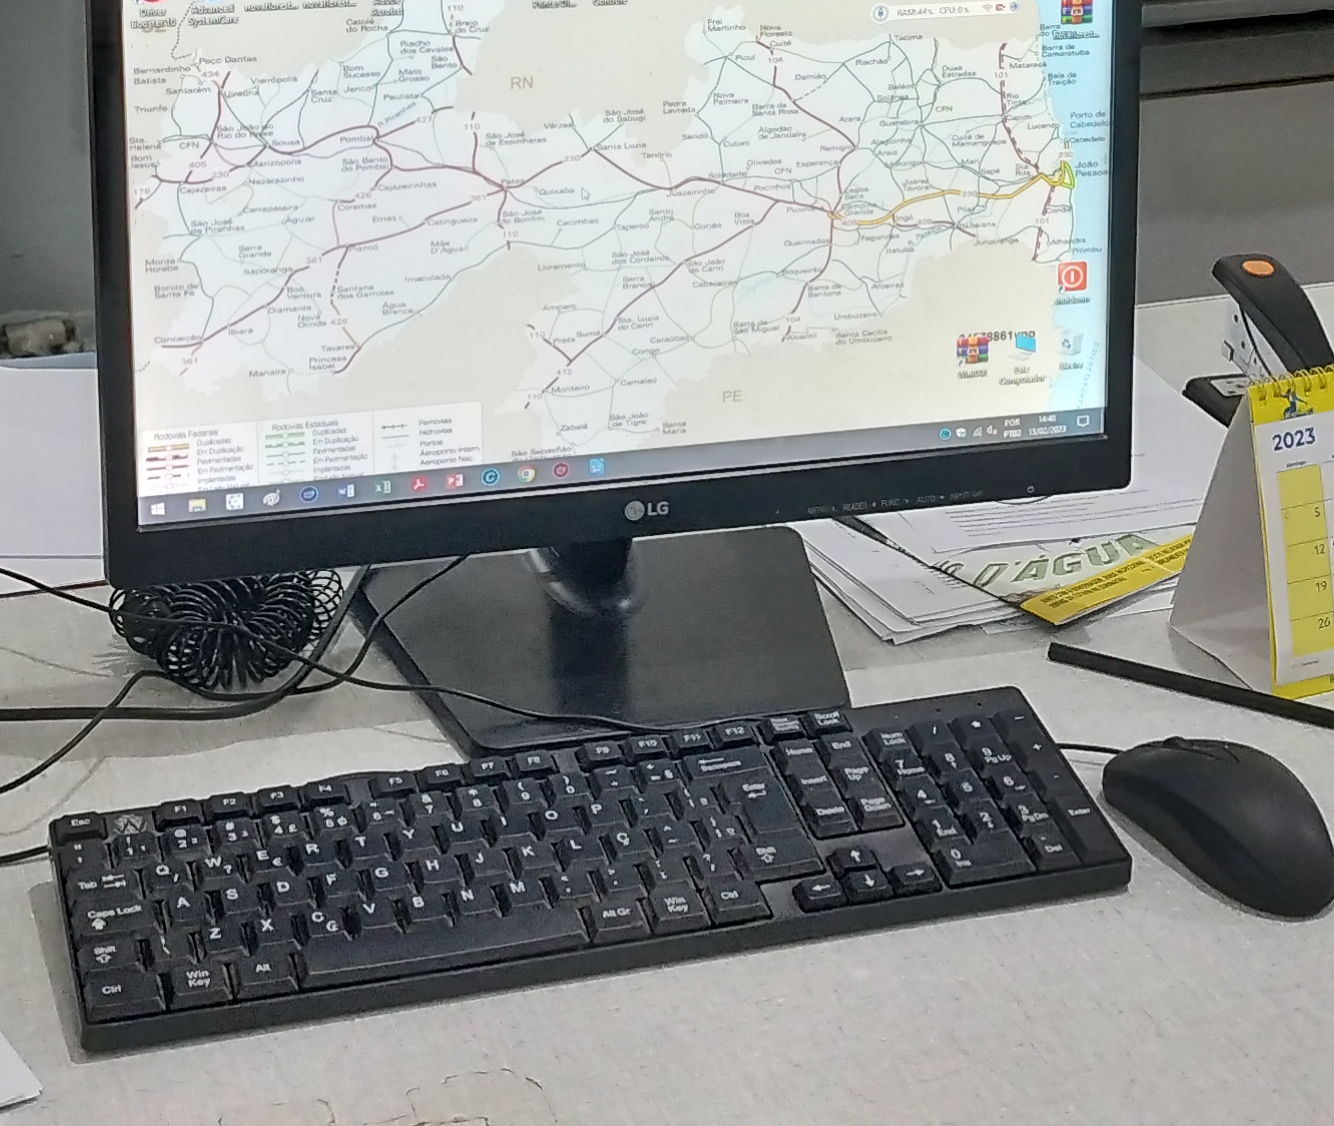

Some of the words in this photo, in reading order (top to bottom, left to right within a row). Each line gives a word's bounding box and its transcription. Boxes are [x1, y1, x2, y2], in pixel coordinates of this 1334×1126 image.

[510, 76, 533, 90] RN
[340, 135, 374, 144] Pombal
[722, 390, 743, 402] PE
[1038, 415, 1056, 423] 14:40
[1028, 425, 1067, 436] 15/02/2023
[1272, 427, 1316, 451] 2023
[647, 502, 669, 516] LG
[1314, 507, 1321, 518] 5
[1313, 544, 1325, 555] 12
[1315, 580, 1327, 592] 19
[1318, 617, 1331, 629] 26
[725, 727, 745, 736] F12
[638, 739, 657, 748] F10
[832, 741, 851, 750] End
[985, 755, 998, 764] Pg
[999, 754, 1012, 762] Up
[270, 791, 285, 800] F3
[222, 798, 237, 806] F2
[174, 805, 188, 813] F1
[591, 803, 603, 815] P
[545, 810, 558, 820] O
[451, 822, 464, 832] U
[403, 829, 415, 840] Y
[355, 836, 366, 847] T
[570, 839, 582, 850] L
[305, 843, 319, 855] R
[521, 846, 535, 857] K
[256, 850, 269, 861] E
[205, 856, 222, 869] W
[426, 859, 440, 871] H
[155, 865, 170, 876] Q
[375, 866, 389, 878] G
[77, 880, 98, 890] Tab
[325, 873, 337, 886] F
[276, 881, 290, 893] D
[510, 882, 526, 894] M
[226, 888, 239, 901] S
[461, 890, 474, 902] N
[721, 890, 739, 900] Ctrl
[176, 896, 190, 909] A
[413, 897, 425, 907] B
[664, 897, 686, 905] Win
[87, 909, 115, 919] Caps
[116, 905, 142, 916] Lock
[363, 903, 376, 914] V
[667, 904, 688, 913] Key
[261, 919, 274, 932] X
[209, 927, 221, 940] Z
[255, 963, 271, 973] Alt
[186, 970, 209, 980] Win
[188, 977, 210, 988] Key
[101, 985, 122, 995] Ctrl
